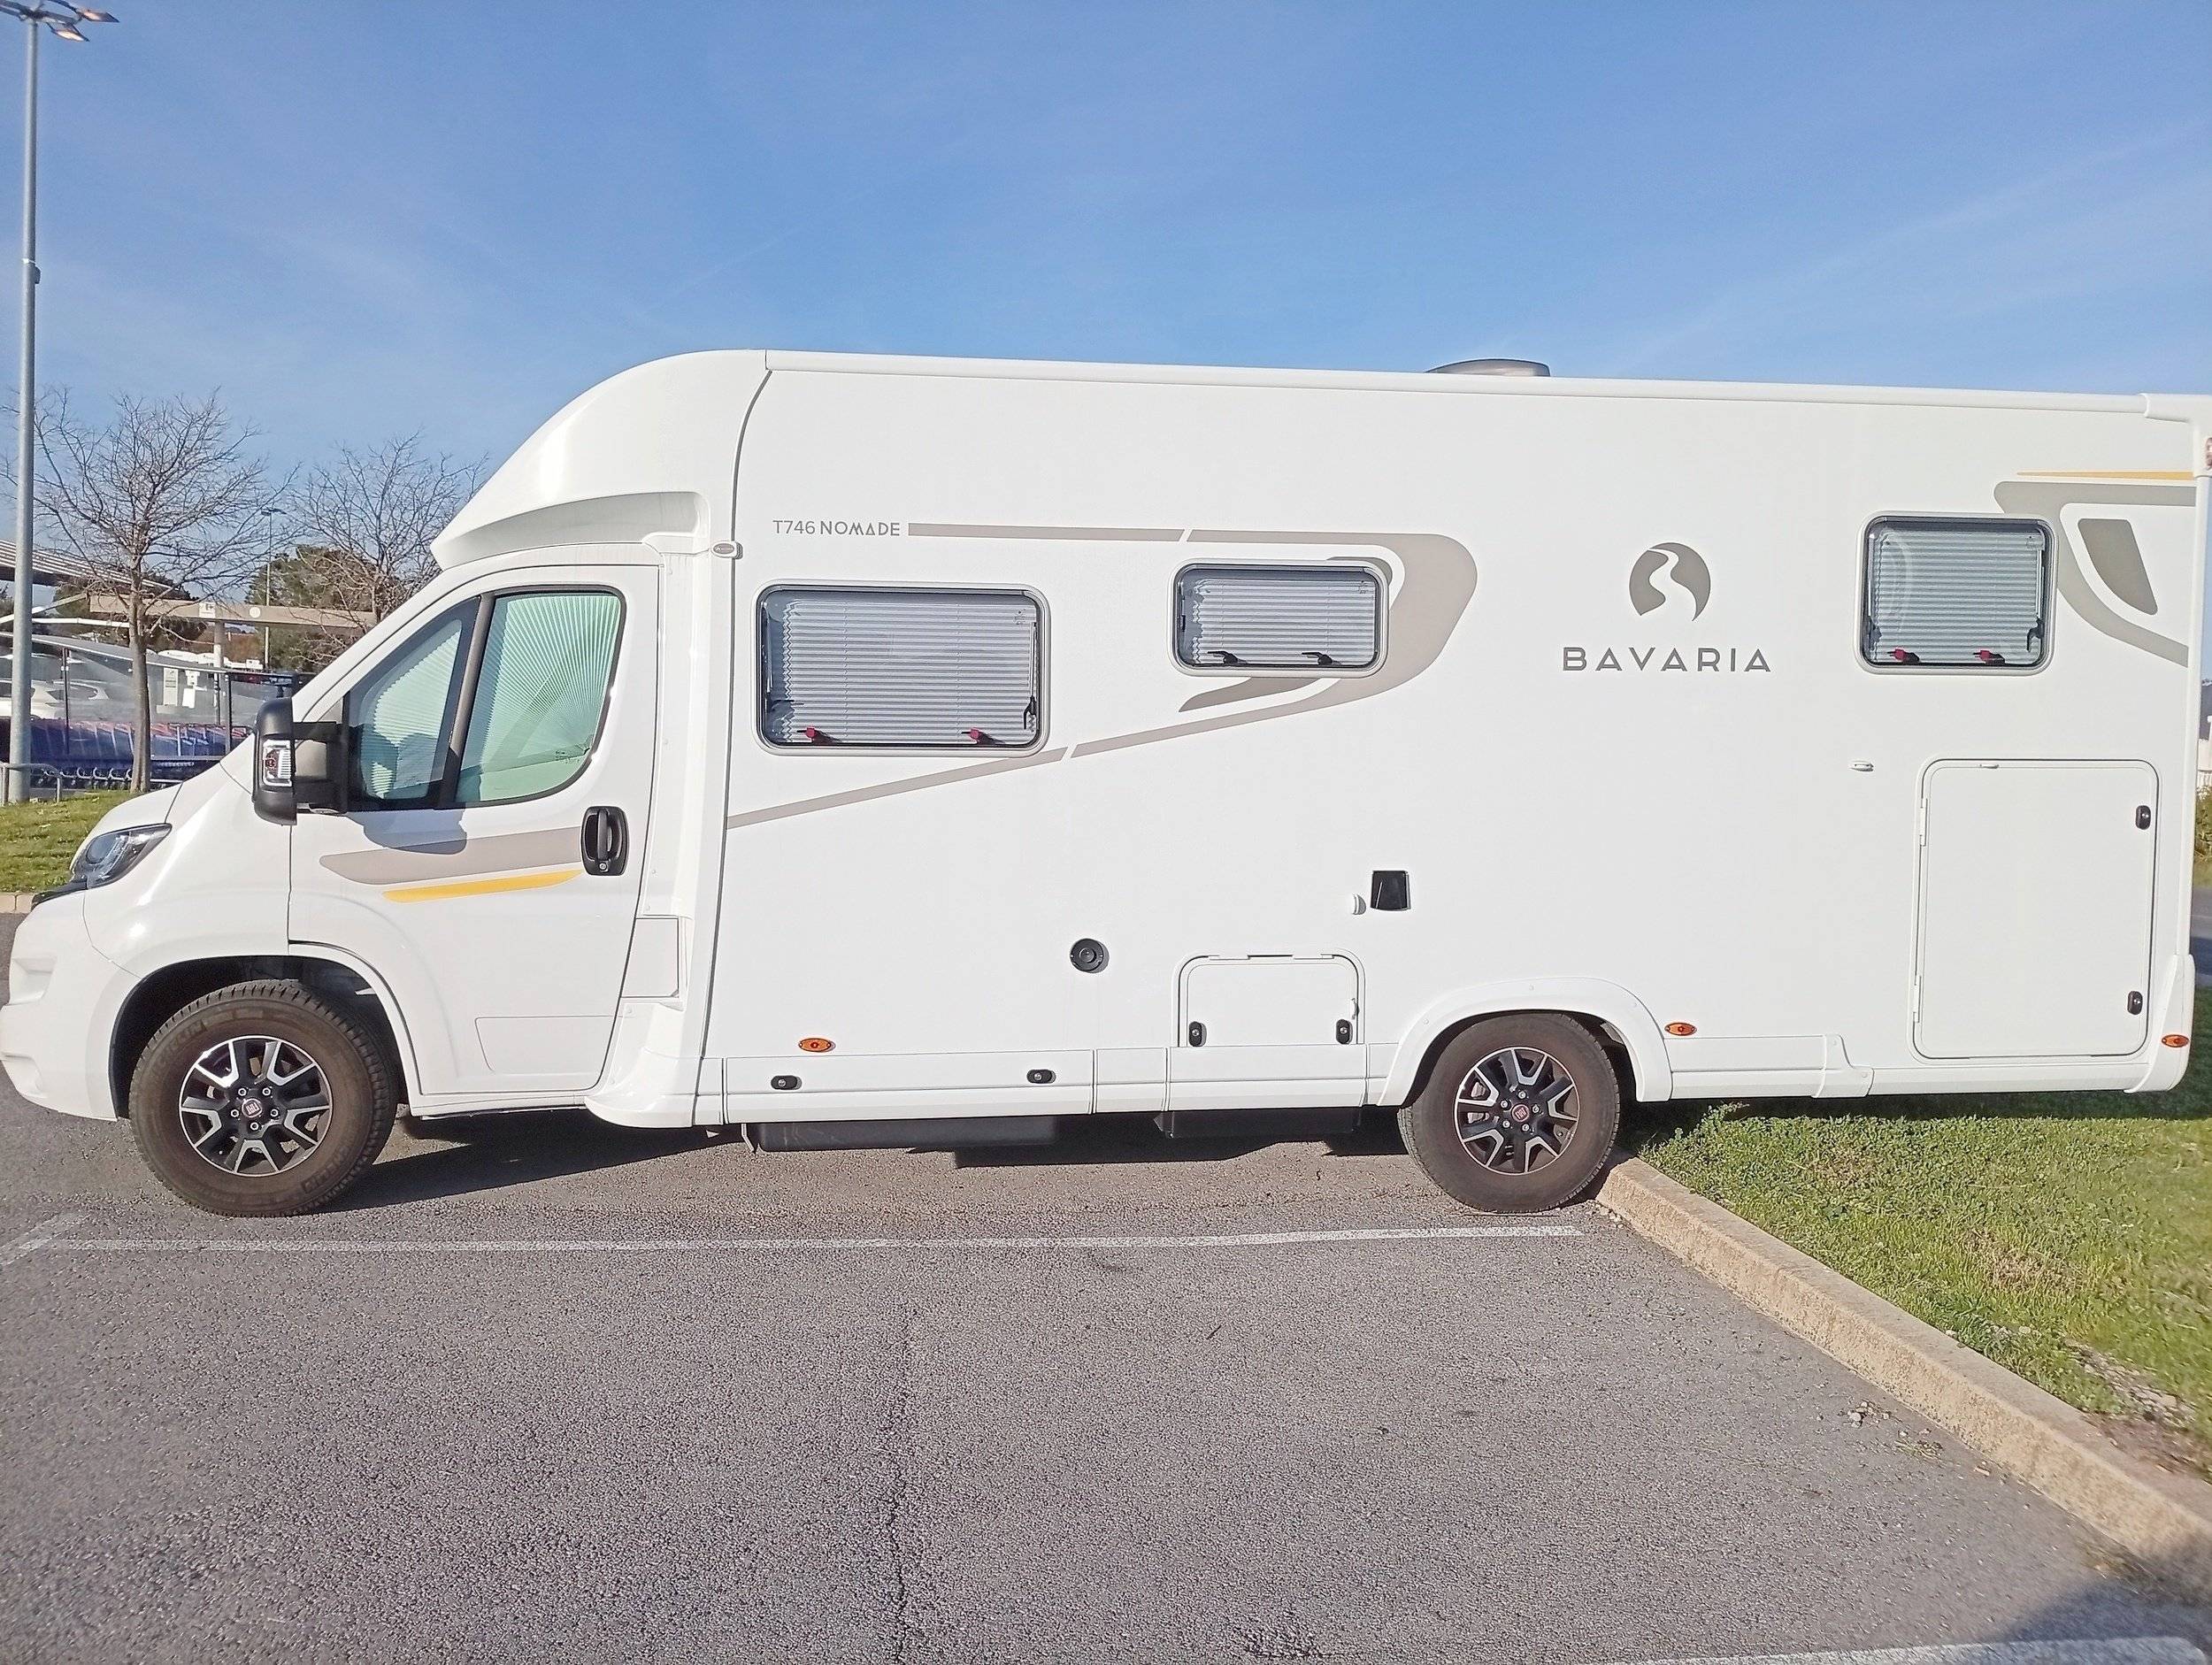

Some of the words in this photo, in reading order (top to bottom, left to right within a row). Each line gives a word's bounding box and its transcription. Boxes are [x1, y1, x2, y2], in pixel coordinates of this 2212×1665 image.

[772, 520, 816, 534] T746
[819, 520, 900, 536] NOMADE
[1562, 647, 1771, 672] BAVARIA
